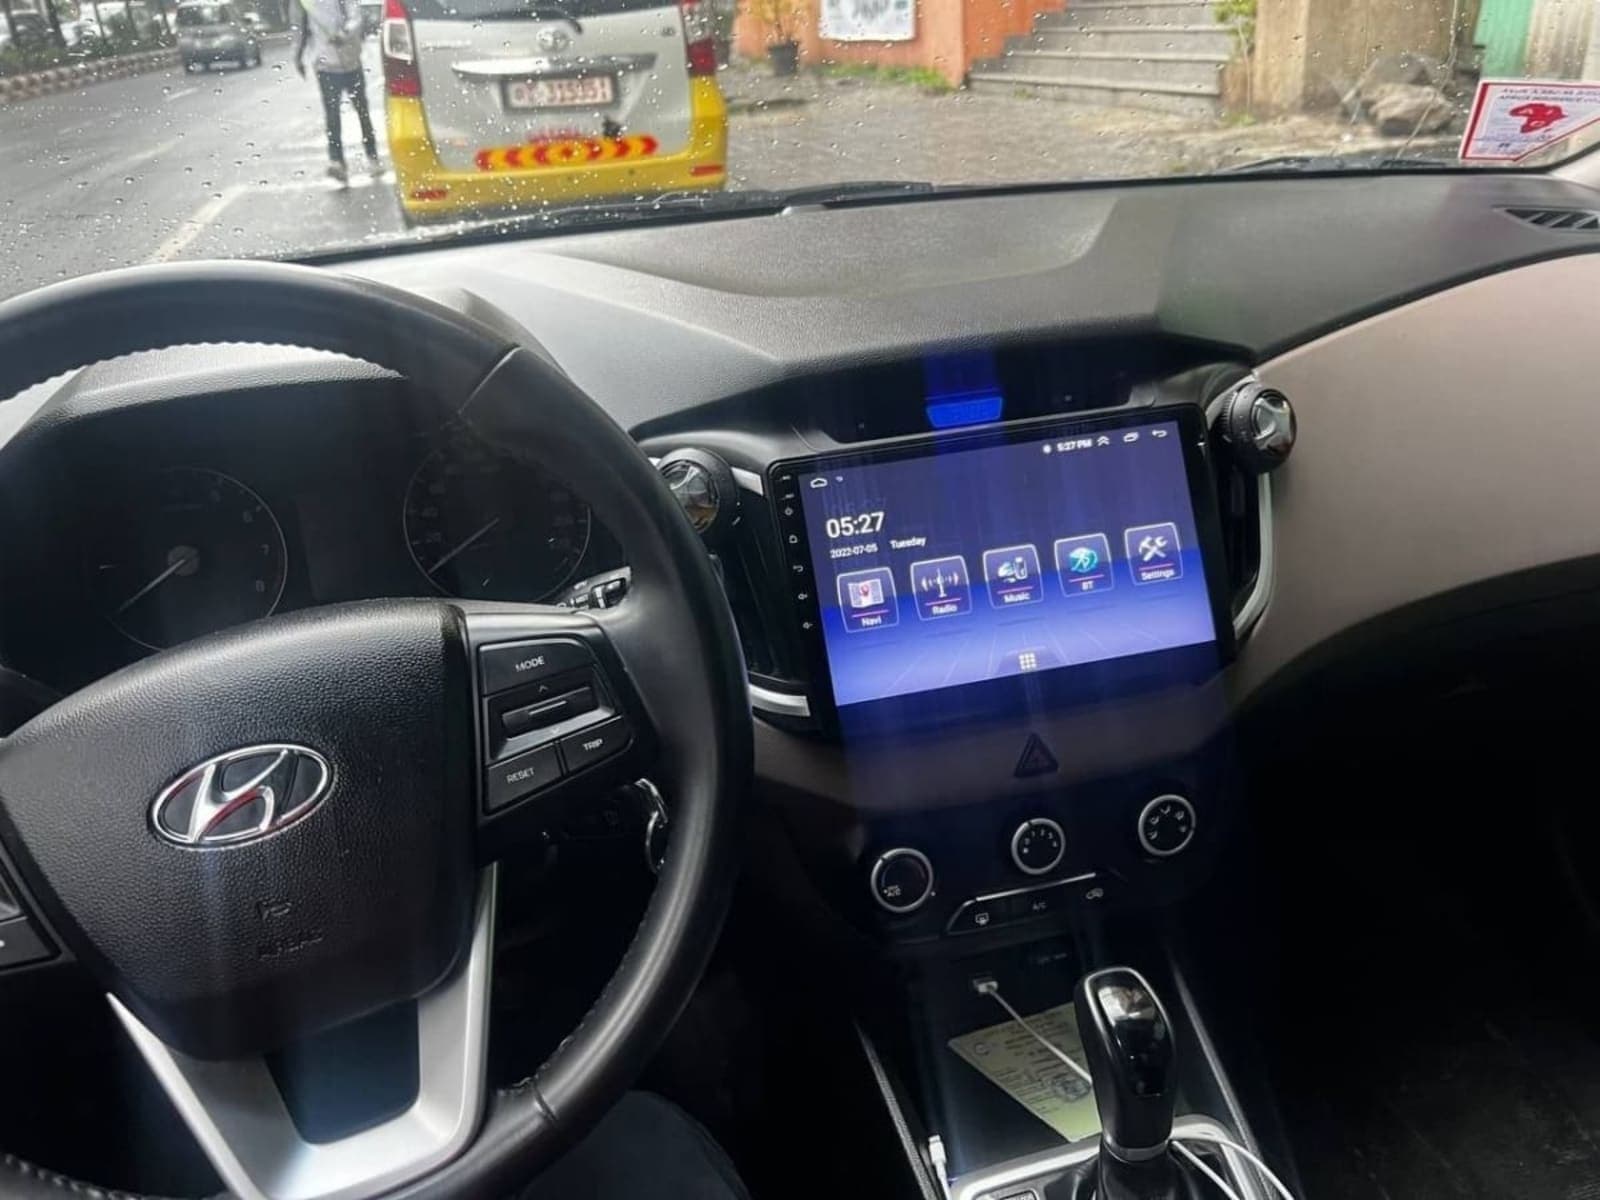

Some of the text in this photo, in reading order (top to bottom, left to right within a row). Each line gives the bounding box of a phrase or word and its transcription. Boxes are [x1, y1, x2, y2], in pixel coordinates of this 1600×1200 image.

[826, 511, 884, 538] 05:27
[830, 536, 926, 558] 2022-07-05 Tuesday
[1141, 569, 1175, 580] Settings
[1082, 580, 1094, 591] BT
[1003, 592, 1030, 603] Music
[932, 604, 958, 615] Radio
[861, 616, 882, 627] Navi
[515, 655, 545, 672] MODE
[582, 738, 604, 751] TRIP
[506, 767, 535, 783] RESET
